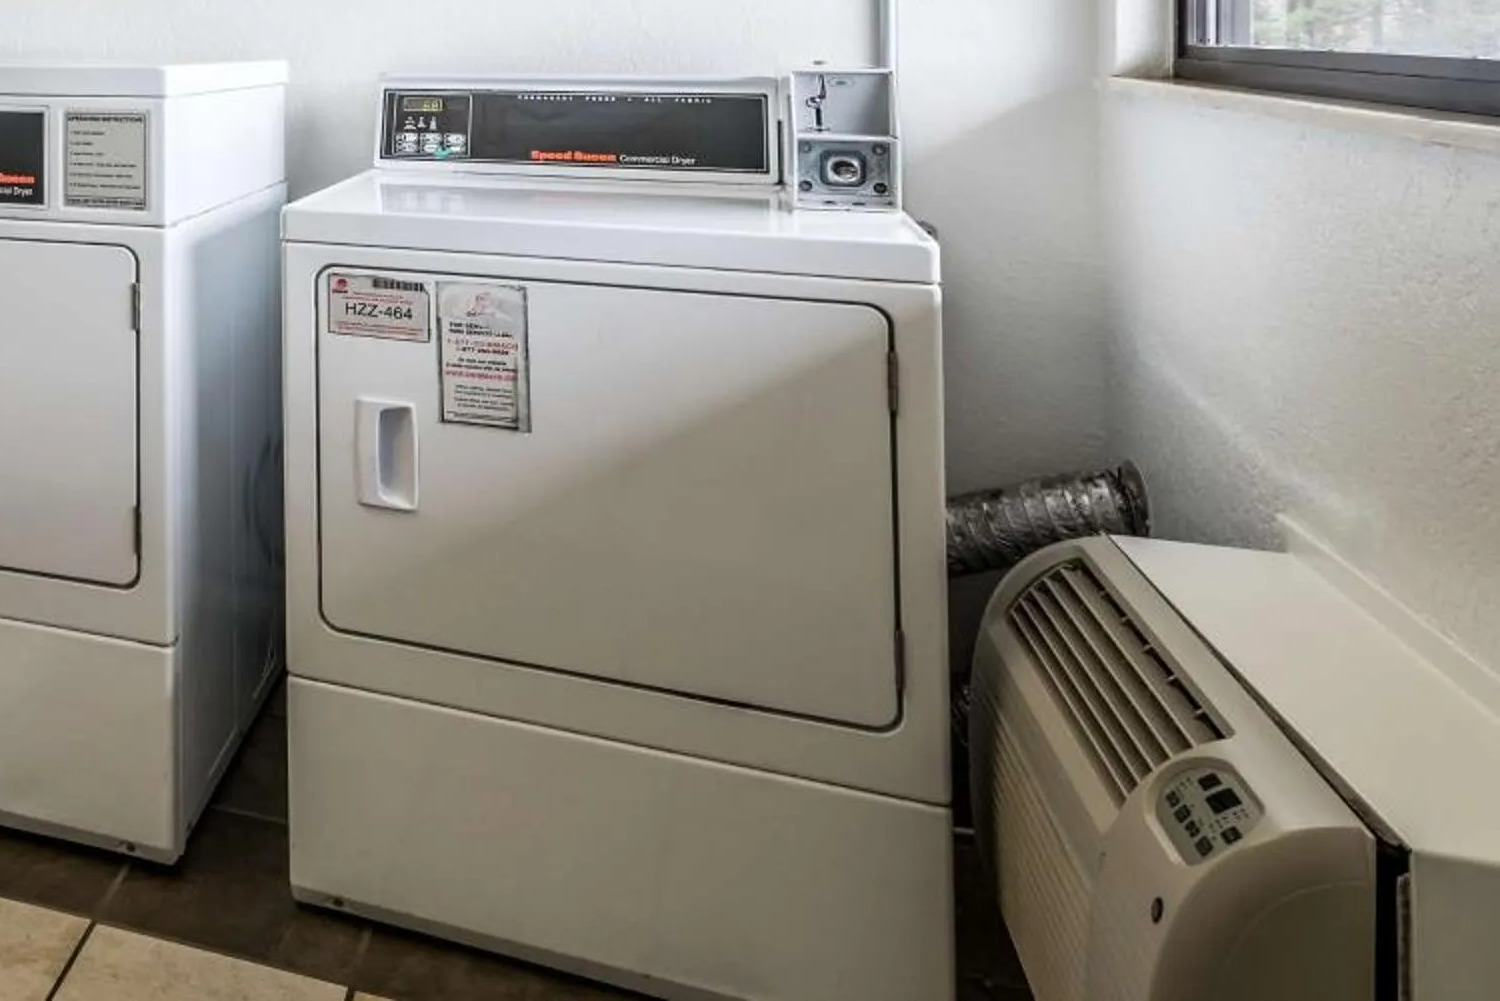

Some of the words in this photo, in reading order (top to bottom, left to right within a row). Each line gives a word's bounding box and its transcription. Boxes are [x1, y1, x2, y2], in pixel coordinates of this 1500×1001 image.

[530, 150, 573, 162] Speed
[619, 154, 670, 164] Commercial
[671, 156, 697, 166] Dryer
[13, 187, 33, 197] Dryer
[345, 302, 413, 320] HZZ-464
